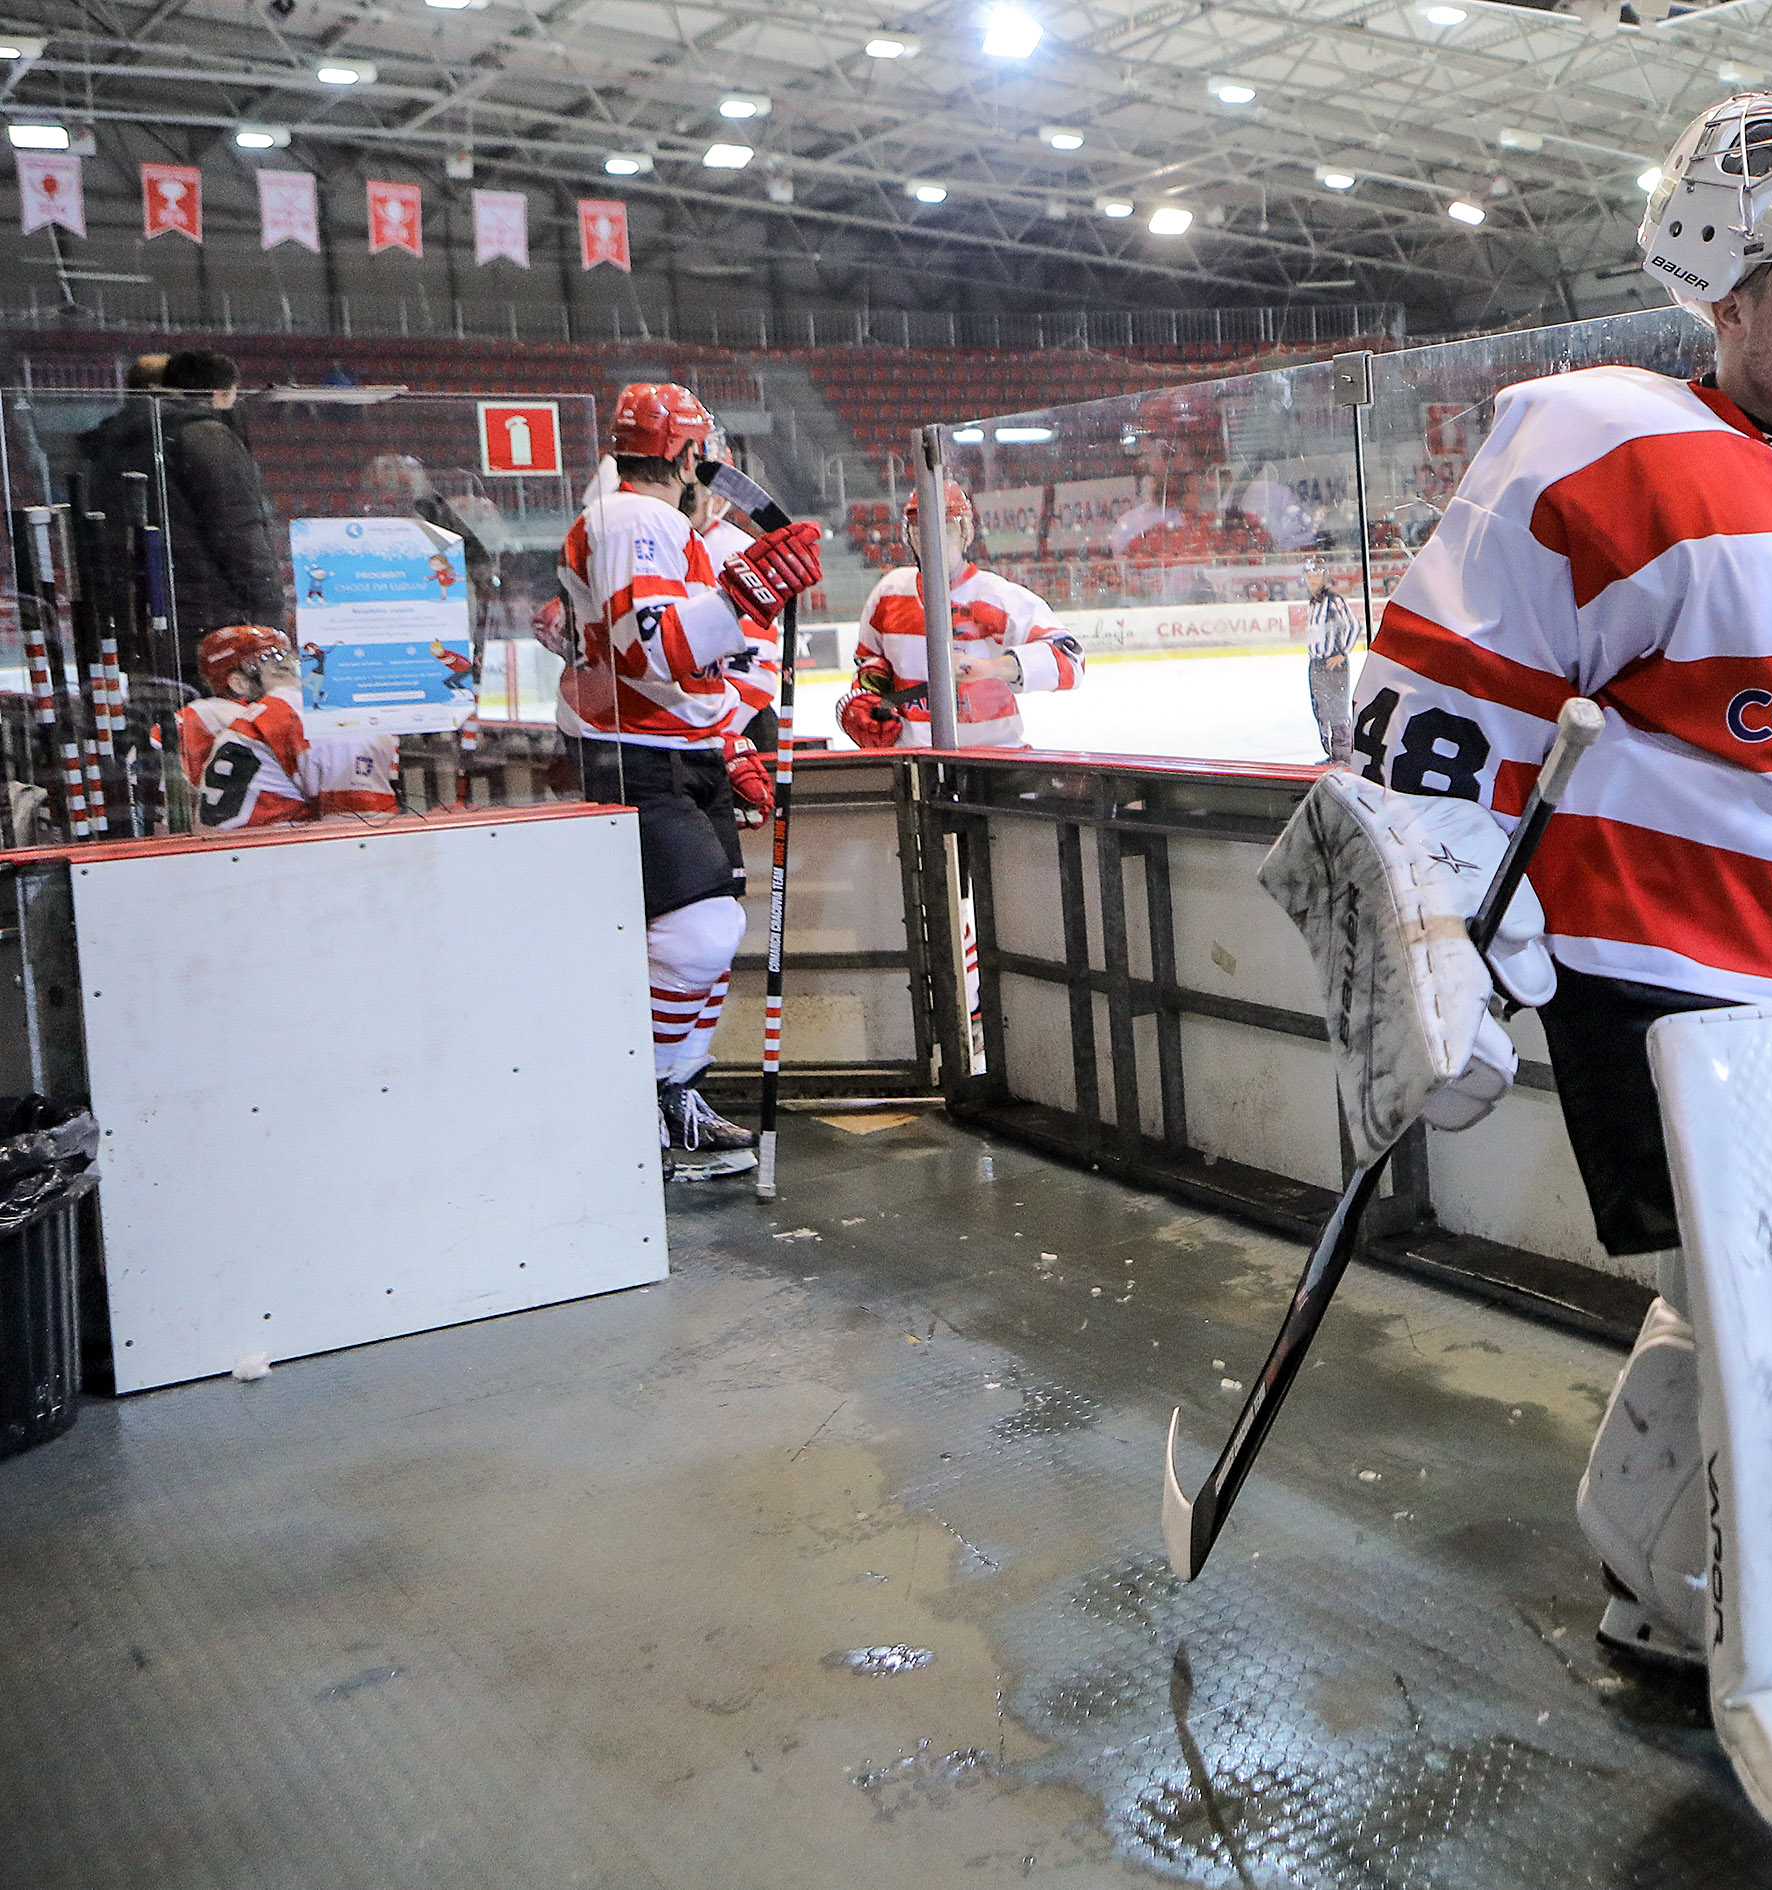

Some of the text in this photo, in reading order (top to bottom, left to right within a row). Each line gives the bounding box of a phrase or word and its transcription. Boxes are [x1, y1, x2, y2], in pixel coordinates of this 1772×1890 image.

[1651, 255, 1710, 291] BAUER
[1157, 617, 1288, 638] CRACOVIA.PL
[1352, 686, 1491, 798] 48
